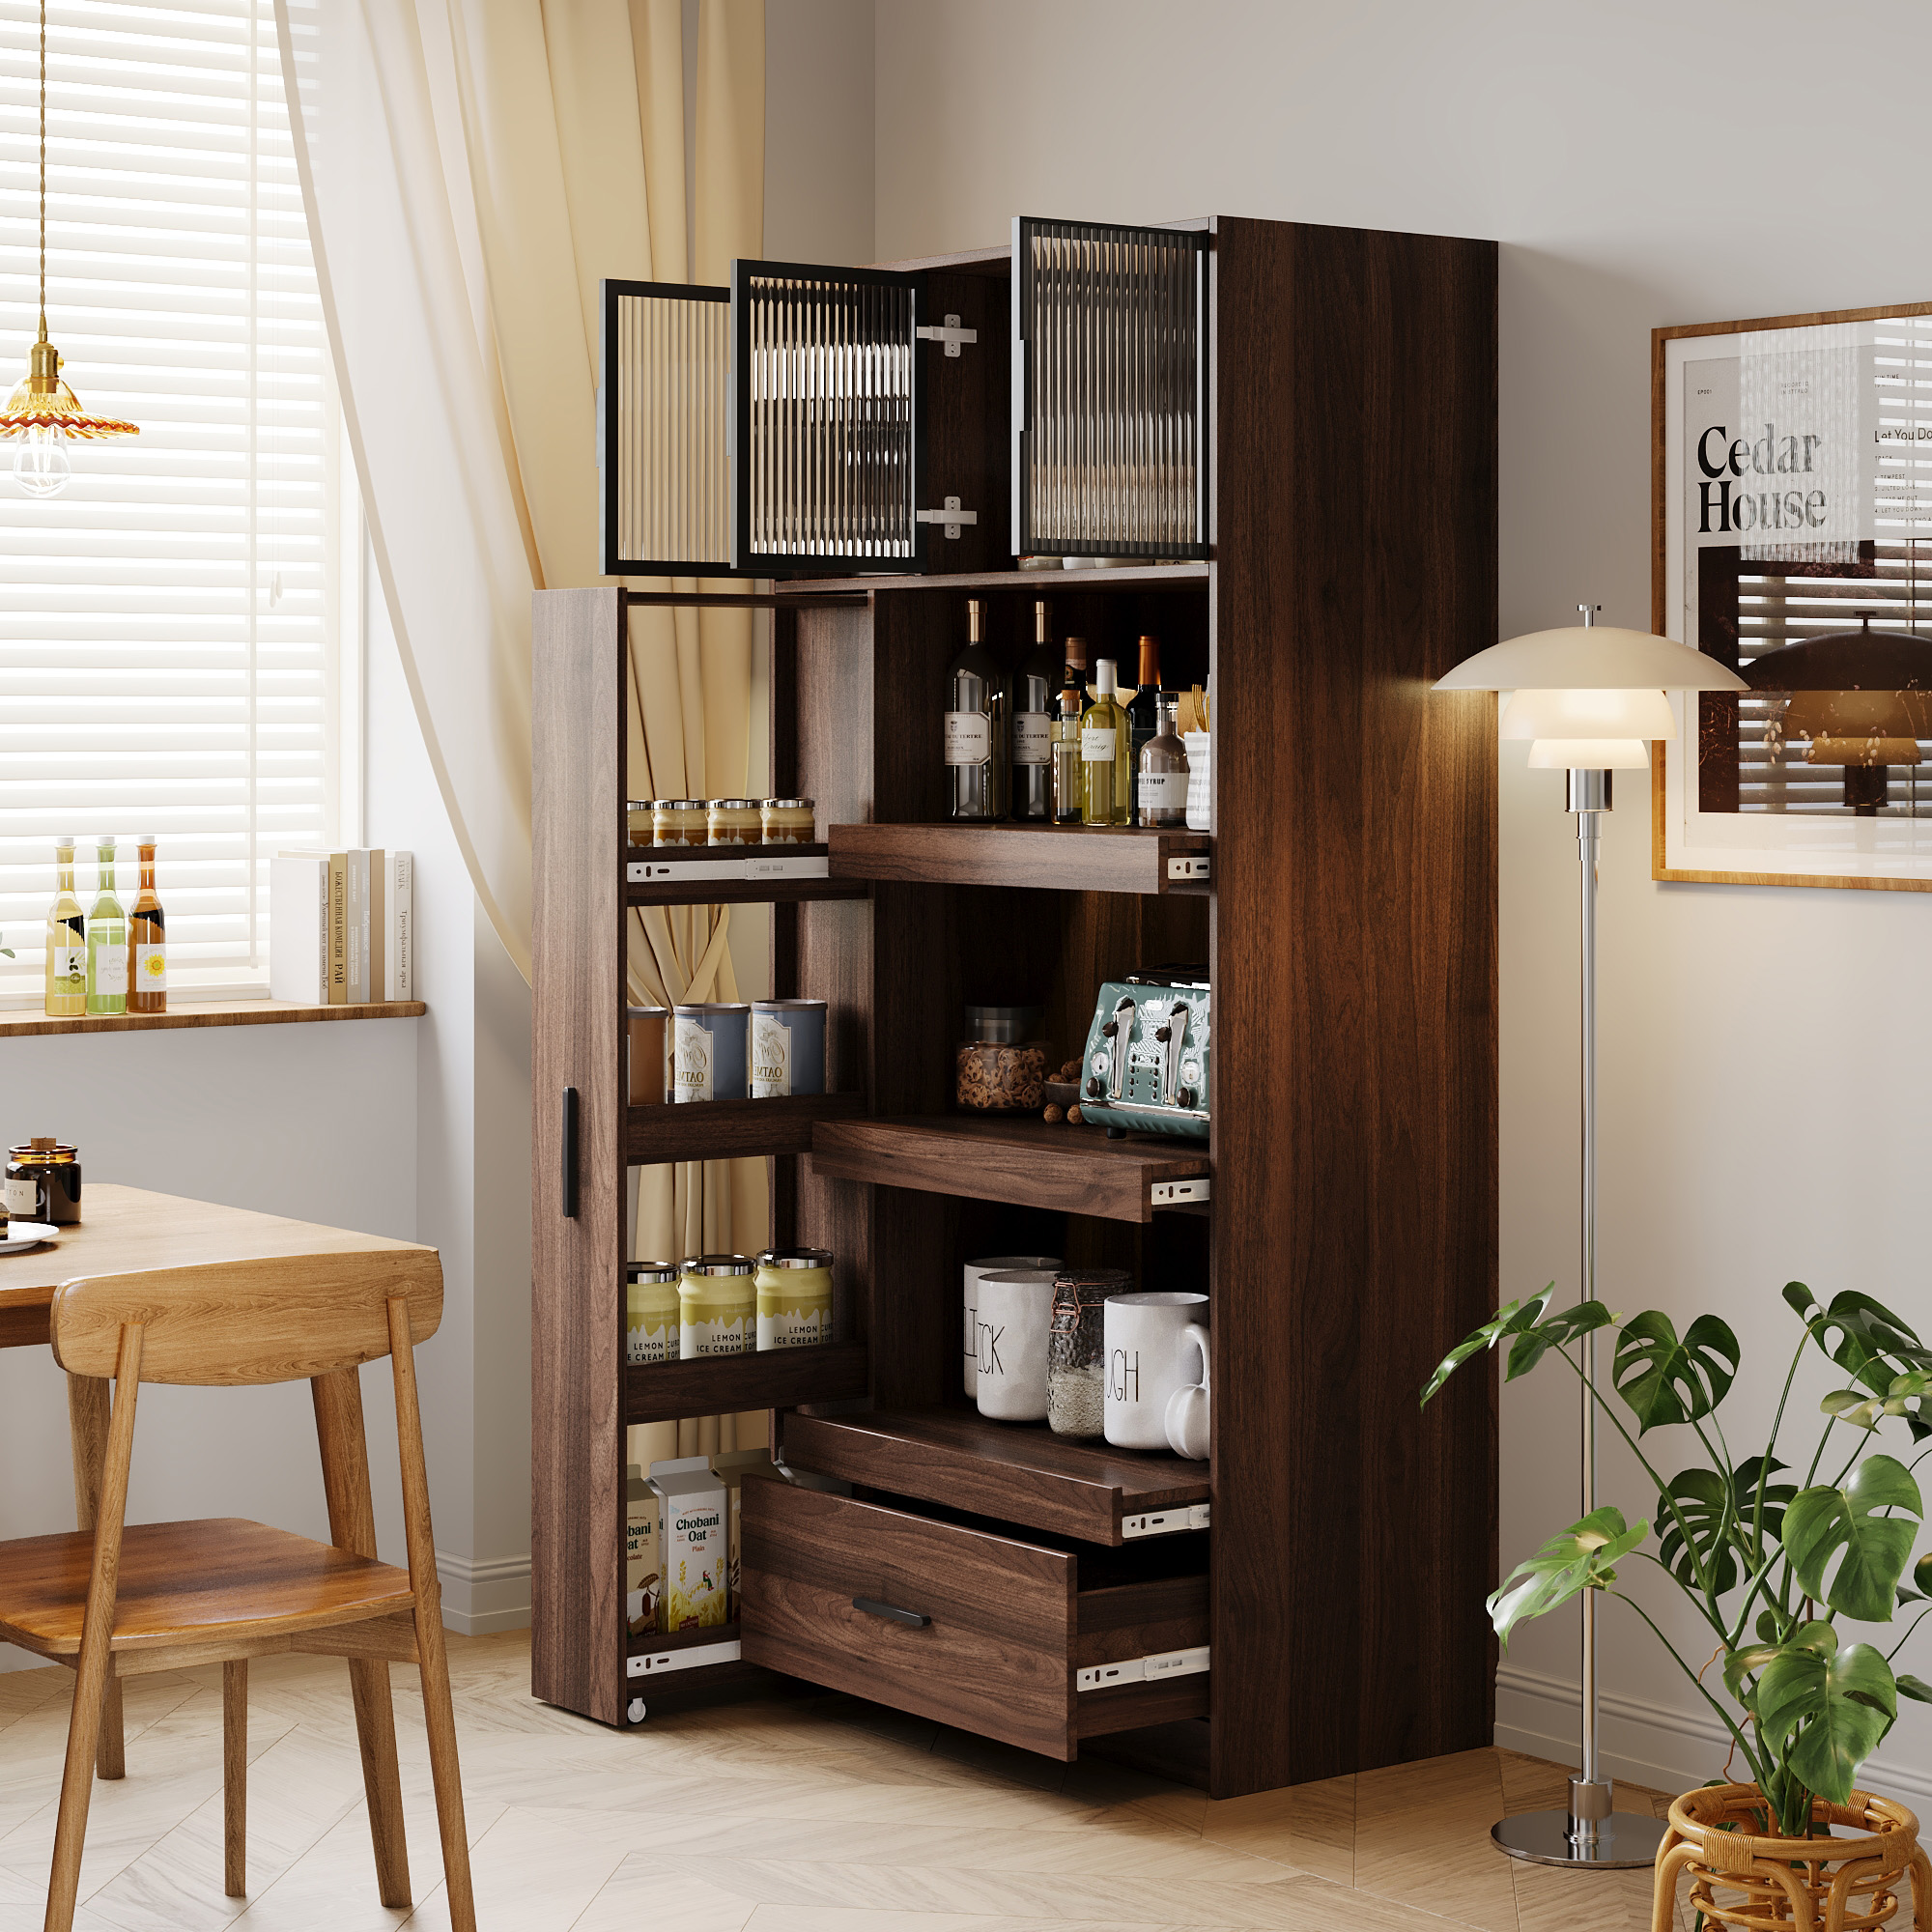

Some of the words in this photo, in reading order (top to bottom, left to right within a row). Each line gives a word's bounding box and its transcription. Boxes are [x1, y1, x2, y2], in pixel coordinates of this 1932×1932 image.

[1875, 430, 1891, 443] Let
[1894, 429, 1915, 440] You
[1697, 422, 1822, 479] Cedar
[1697, 480, 1828, 533] House
[399, 910, 408, 968] Триумфальная
[334, 964, 345, 984] РАЙ
[788, 1325, 817, 1334] LEMON
[711, 1333, 741, 1342] LEMON
[774, 1336, 787, 1345] ICE
[790, 1336, 818, 1345] CREAM
[634, 1342, 664, 1350] LEMON
[713, 1344, 742, 1352] CREAM
[635, 1352, 665, 1361] CREAM
[627, 1521, 651, 1537] bani
[676, 1513, 720, 1531] Chobani
[688, 1529, 707, 1543] Oat
[627, 1538, 639, 1550] at
